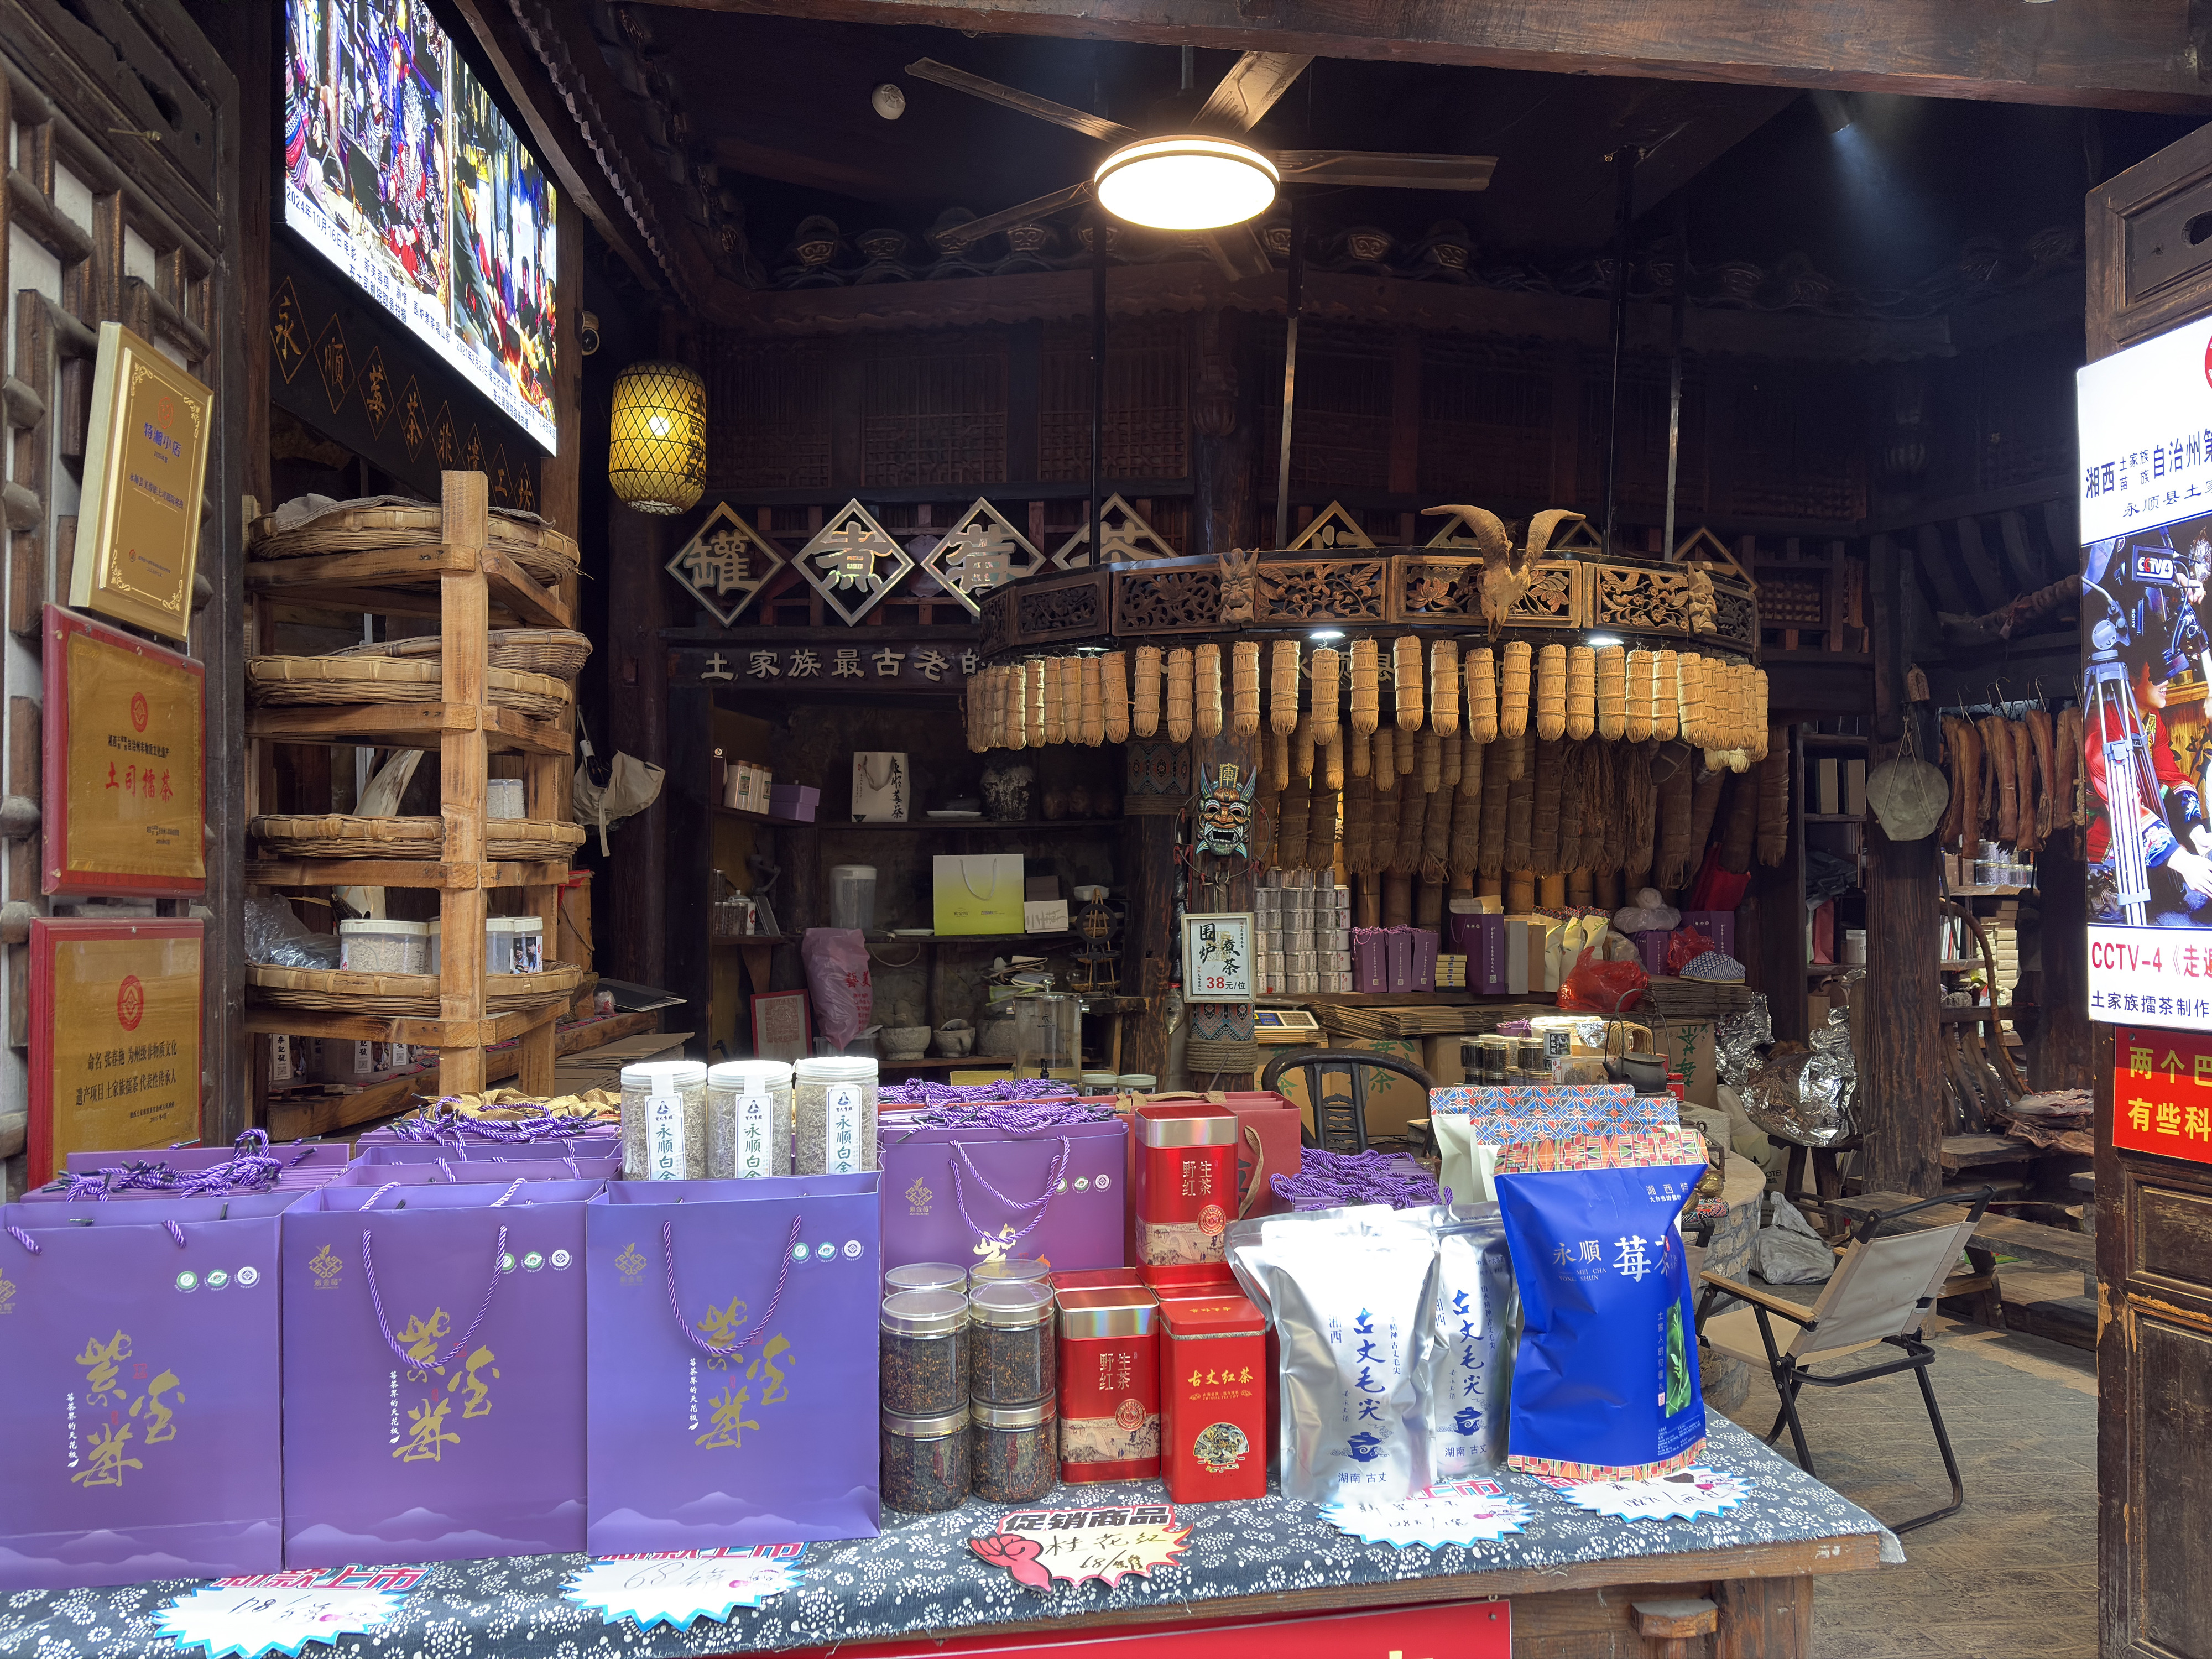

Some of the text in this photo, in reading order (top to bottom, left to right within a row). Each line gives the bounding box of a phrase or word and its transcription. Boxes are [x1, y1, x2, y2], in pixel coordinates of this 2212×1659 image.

[2086, 461, 2115, 498] 湘西
[105, 761, 173, 802] 土司擂茶
[2091, 990, 2210, 1018] 土家族擂茶制作
[2128, 1097, 2212, 1142] 有些科
[1188, 1366, 1254, 1387] 古丈红茶
[1353, 1307, 1386, 1421] 古丈毛尖
[389, 1370, 399, 1436] 莓茶界的天花板
[689, 1358, 698, 1422] 莓茶界的天花板
[66, 1392, 78, 1460] 莓茶界的天花板
[1444, 1442, 1488, 1458] 湖南 古丈
[1338, 1472, 1387, 1484] 湖南 古丈
[1004, 1507, 1171, 1532] 促销商品
